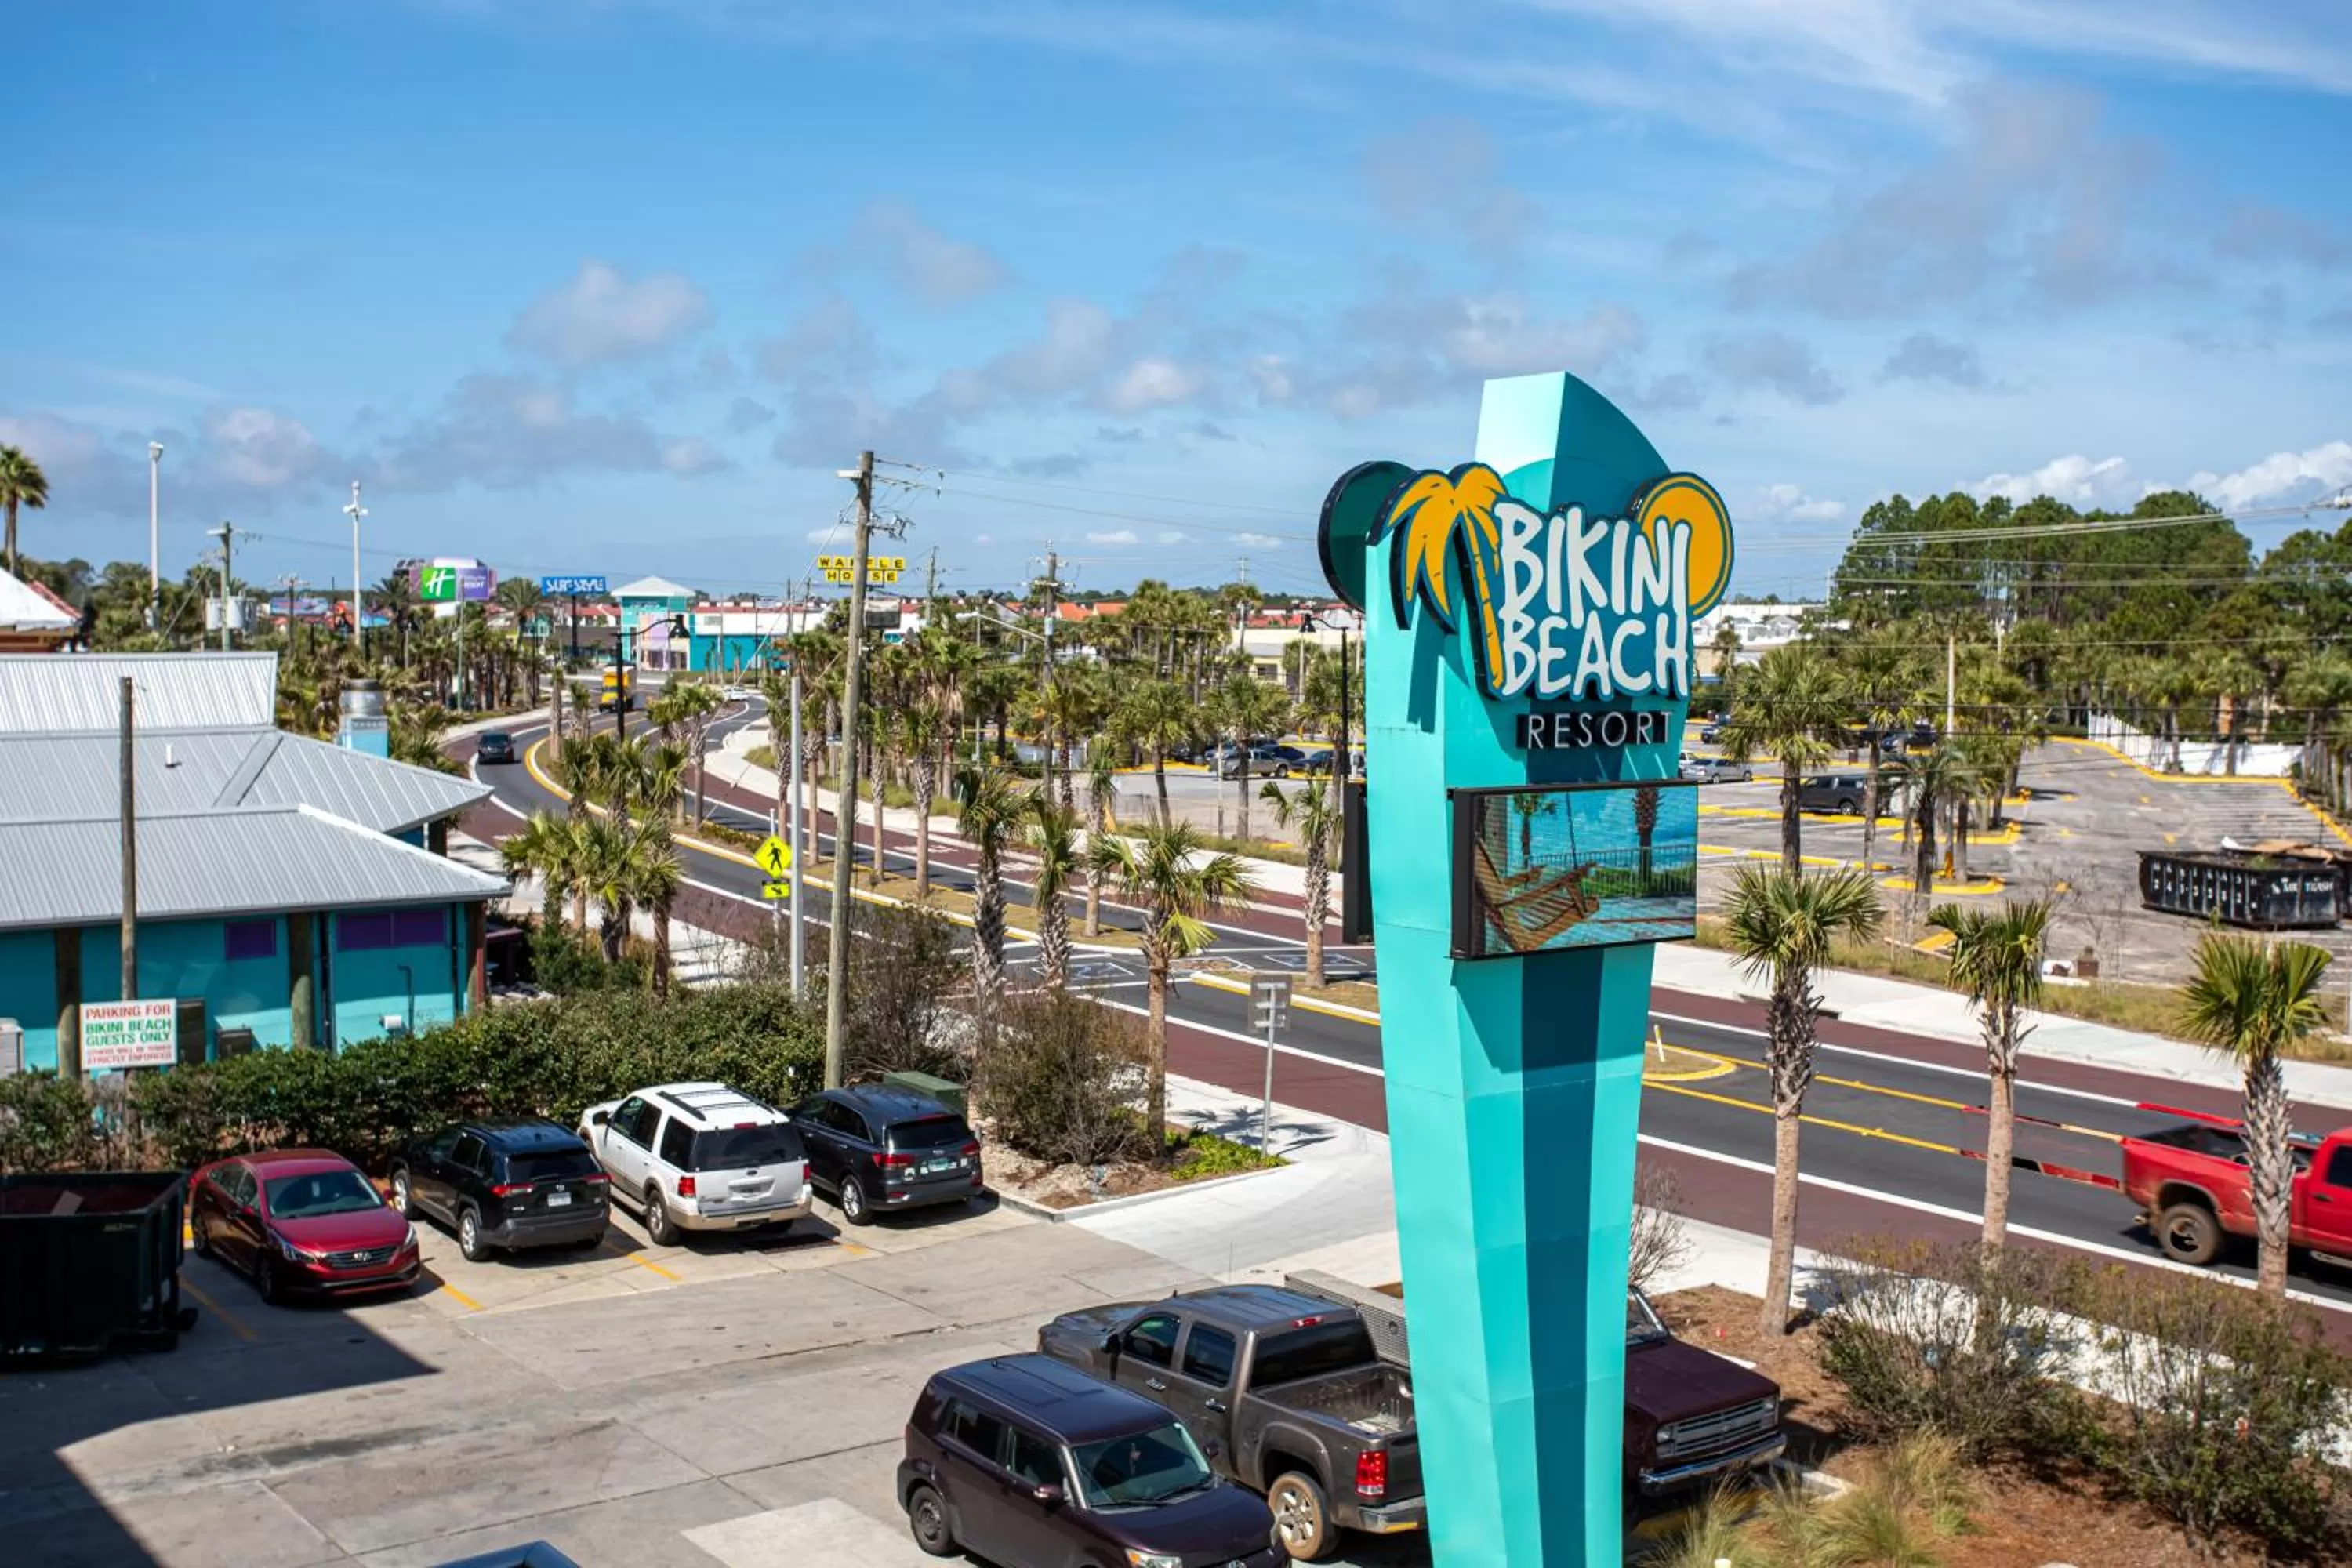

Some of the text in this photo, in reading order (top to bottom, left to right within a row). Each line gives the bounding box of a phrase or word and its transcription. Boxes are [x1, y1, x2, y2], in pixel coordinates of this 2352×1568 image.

[819, 557, 904, 568] WAFLE
[1494, 502, 1692, 628] BIKINI
[827, 572, 895, 581] HOSE
[1498, 610, 1689, 697] BEACH
[1528, 711, 1672, 750] RESORT
[86, 1003, 170, 1019] PARKING FOR
[86, 1018, 172, 1034] BIKINI BEACH
[86, 1032, 170, 1047] GUESTS ONLY
